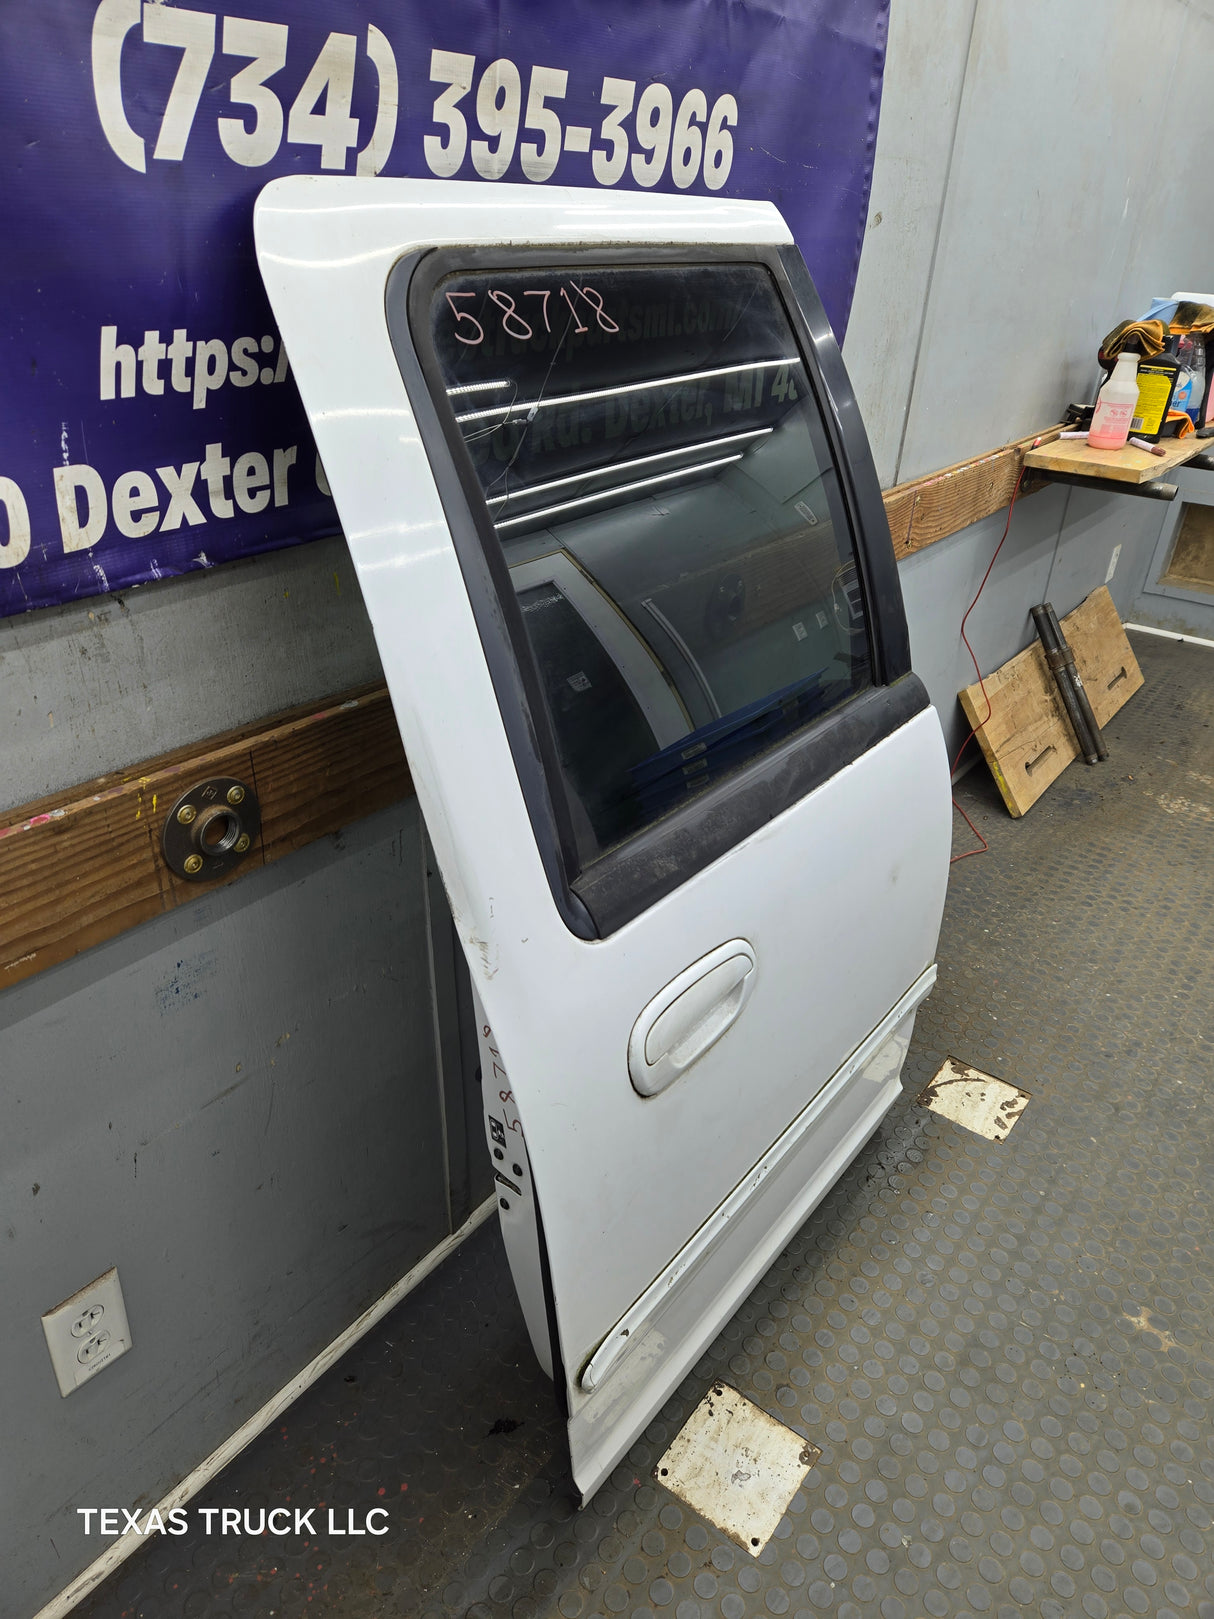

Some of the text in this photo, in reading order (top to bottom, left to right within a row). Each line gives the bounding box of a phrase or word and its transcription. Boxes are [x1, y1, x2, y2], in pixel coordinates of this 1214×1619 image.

[92, 0, 738, 190] (734) 395-3966
[445, 280, 620, 345] 58718
[53, 442, 298, 554] Dexter
